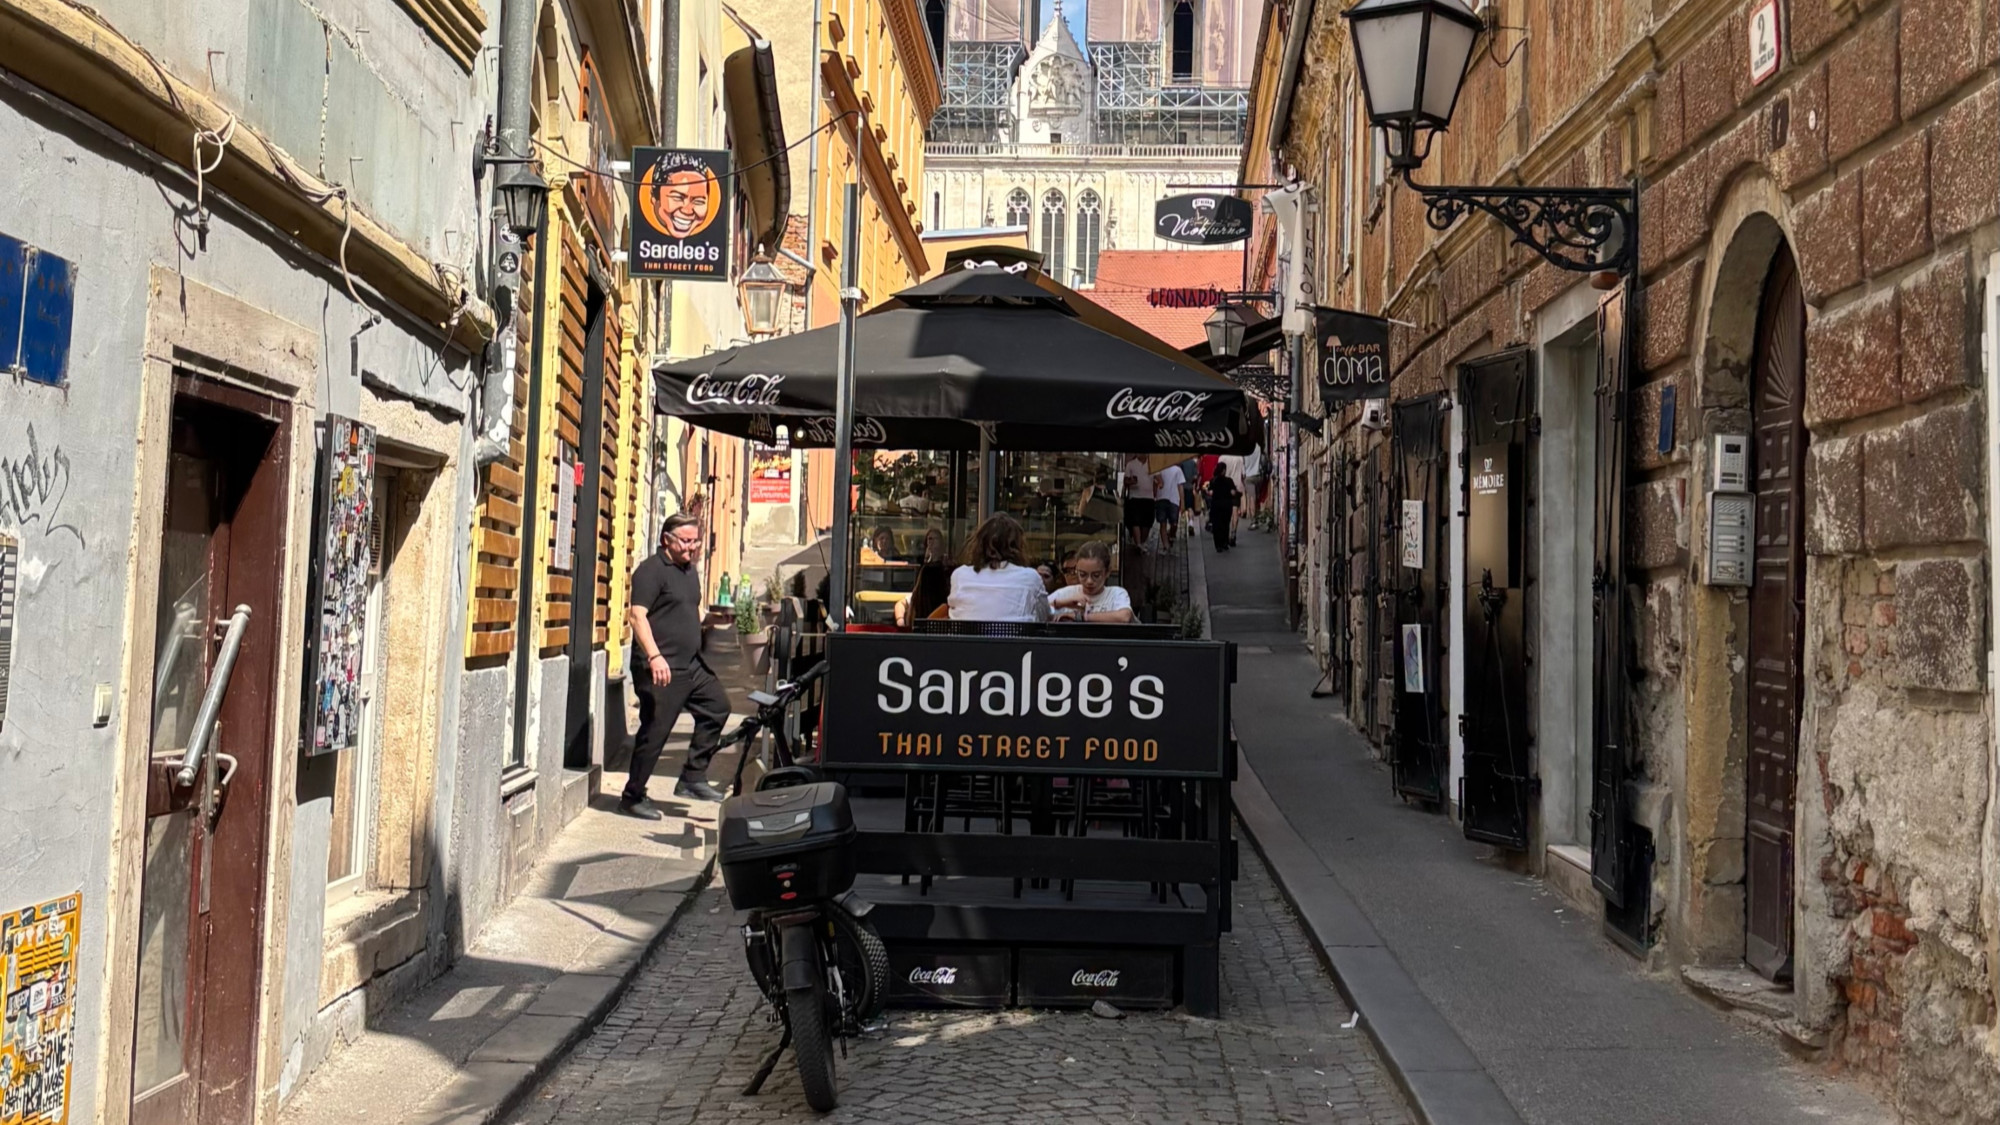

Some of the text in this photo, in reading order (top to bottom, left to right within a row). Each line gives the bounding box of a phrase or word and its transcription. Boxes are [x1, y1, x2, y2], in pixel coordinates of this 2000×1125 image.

[1757, 13, 1767, 55] 2
[1159, 213, 1246, 239] Nokturno
[639, 239, 720, 261] Saralee's
[1358, 343, 1380, 354] BAR
[686, 372, 786, 406] Coca-Cola
[1106, 387, 1213, 422] Coca-Cola
[877, 650, 1165, 720] Saralee's
[878, 732, 1159, 762] THAI STREET FOOD
